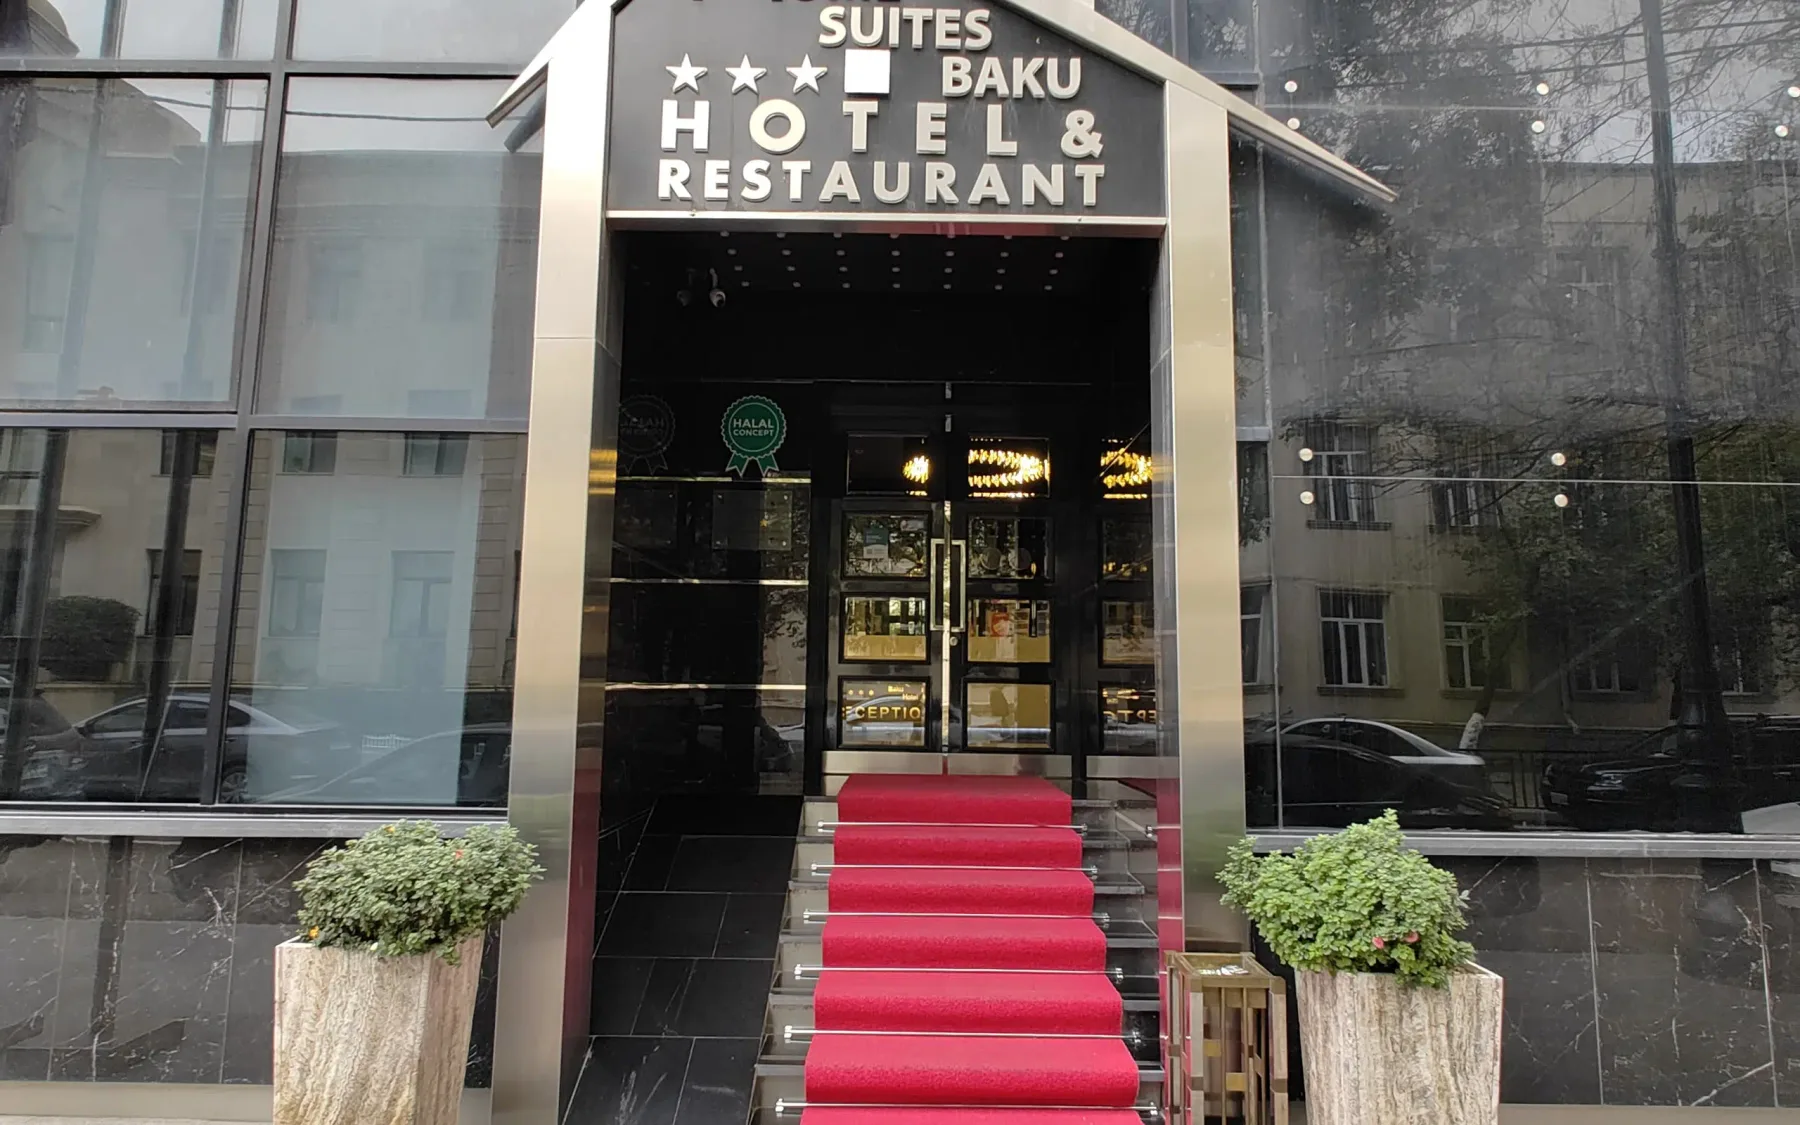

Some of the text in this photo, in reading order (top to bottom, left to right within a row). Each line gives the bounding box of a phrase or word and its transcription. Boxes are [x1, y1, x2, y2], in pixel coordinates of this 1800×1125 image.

[818, 5, 993, 51] SUITES
[941, 55, 1082, 100] BAKU
[660, 98, 1105, 159] HOTEL &
[657, 158, 1105, 207] RESTAURANT
[733, 418, 774, 429] HALAL
[733, 429, 774, 437] CONCEPT
